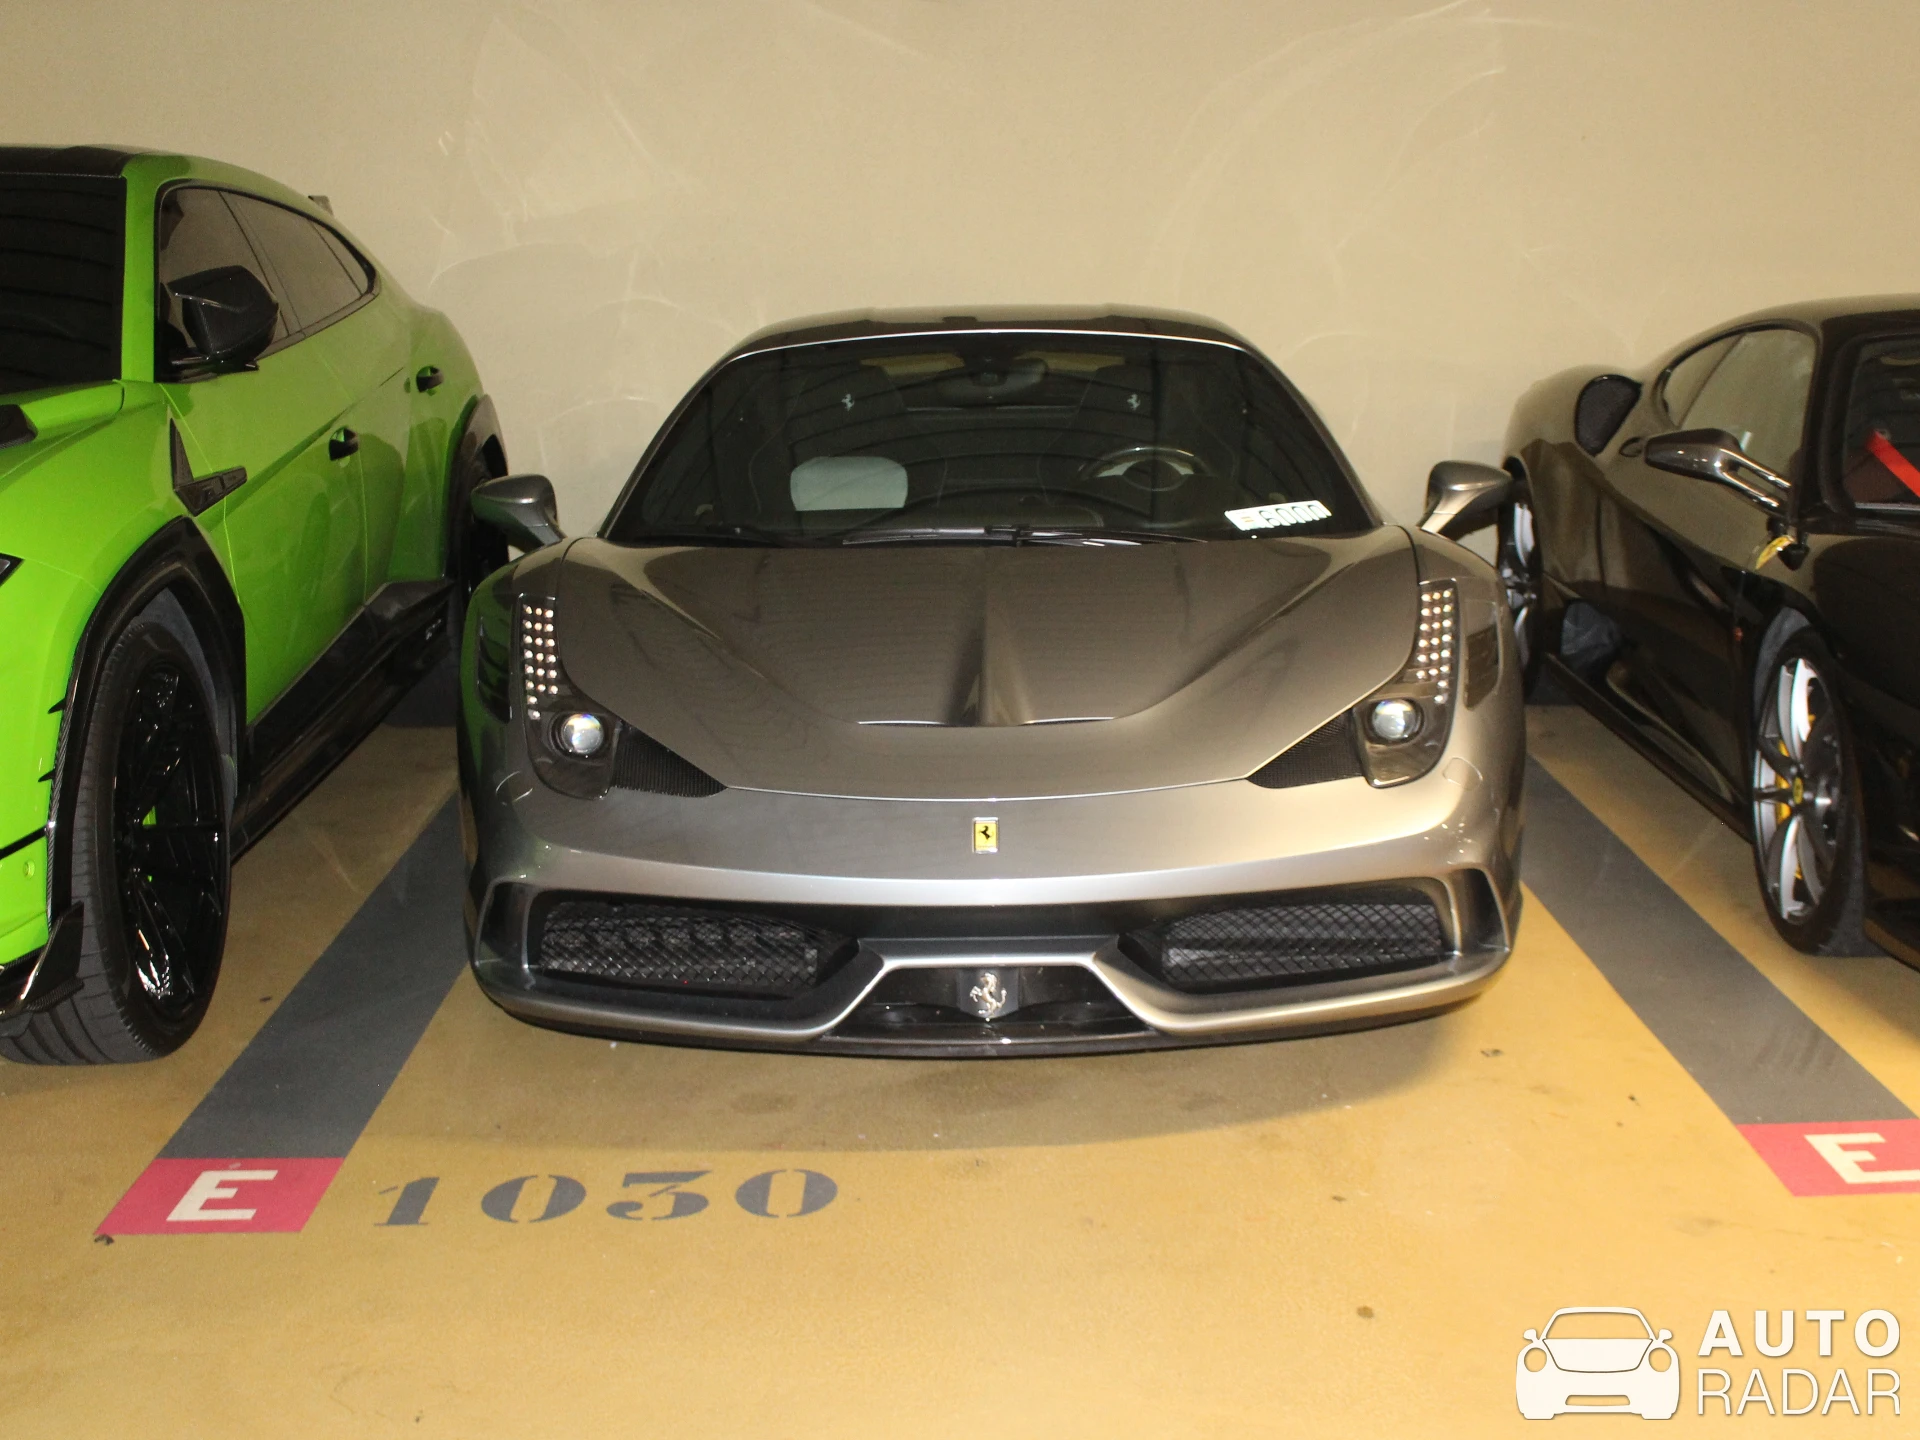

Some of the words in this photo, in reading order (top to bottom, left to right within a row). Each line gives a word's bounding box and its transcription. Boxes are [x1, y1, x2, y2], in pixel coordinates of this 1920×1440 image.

[1804, 1132, 1920, 1184] E
[166, 1170, 278, 1221] E
[374, 1169, 838, 1226] 1030
